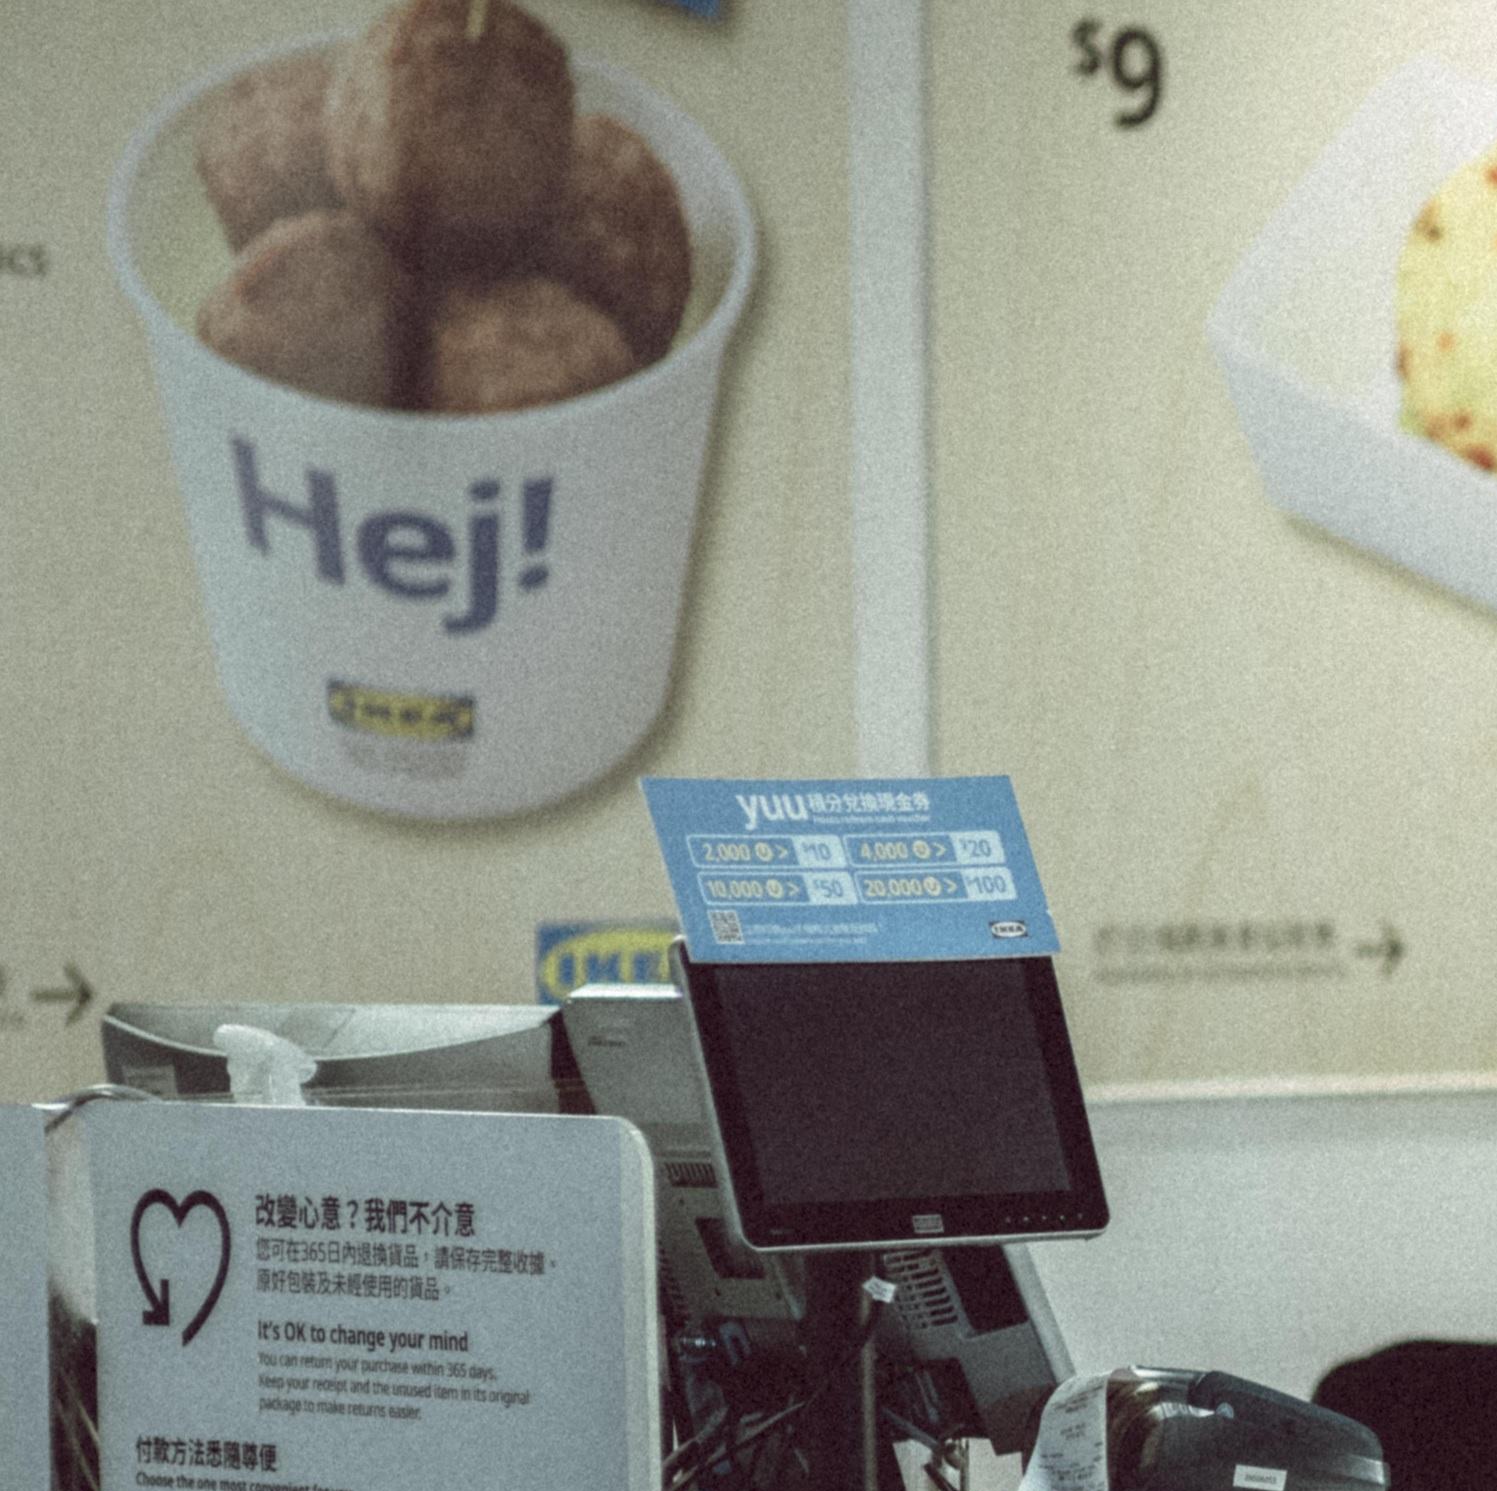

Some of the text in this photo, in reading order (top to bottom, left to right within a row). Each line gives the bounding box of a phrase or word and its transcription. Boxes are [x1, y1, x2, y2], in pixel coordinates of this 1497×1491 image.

[1070, 18, 1165, 130] $9
[231, 434, 556, 636] Hej!
[735, 793, 809, 831] yuu
[703, 843, 750, 863] 2,000
[860, 842, 908, 861] 4,000
[706, 879, 763, 899] 10,000
[864, 877, 922, 898] 20,000
[258, 1320, 470, 1353] It's OK to change your mind
[258, 1351, 277, 1367] You
[279, 1355, 298, 1369] can
[301, 1356, 333, 1371] return
[335, 1360, 358, 1376] your
[361, 1360, 409, 1376] purchase
[411, 1361, 445, 1377] within
[446, 1363, 467, 1379] 365
[258, 1375, 531, 1408] Keep your receipt and the unused item in its original
[258, 1396, 301, 1416] package
[302, 1400, 315, 1413] to
[316, 1400, 345, 1416] make
[347, 1402, 386, 1419] returns
[136, 1471, 174, 1489] Choose
[176, 1473, 195, 1489] the
[197, 1477, 217, 1491] one
